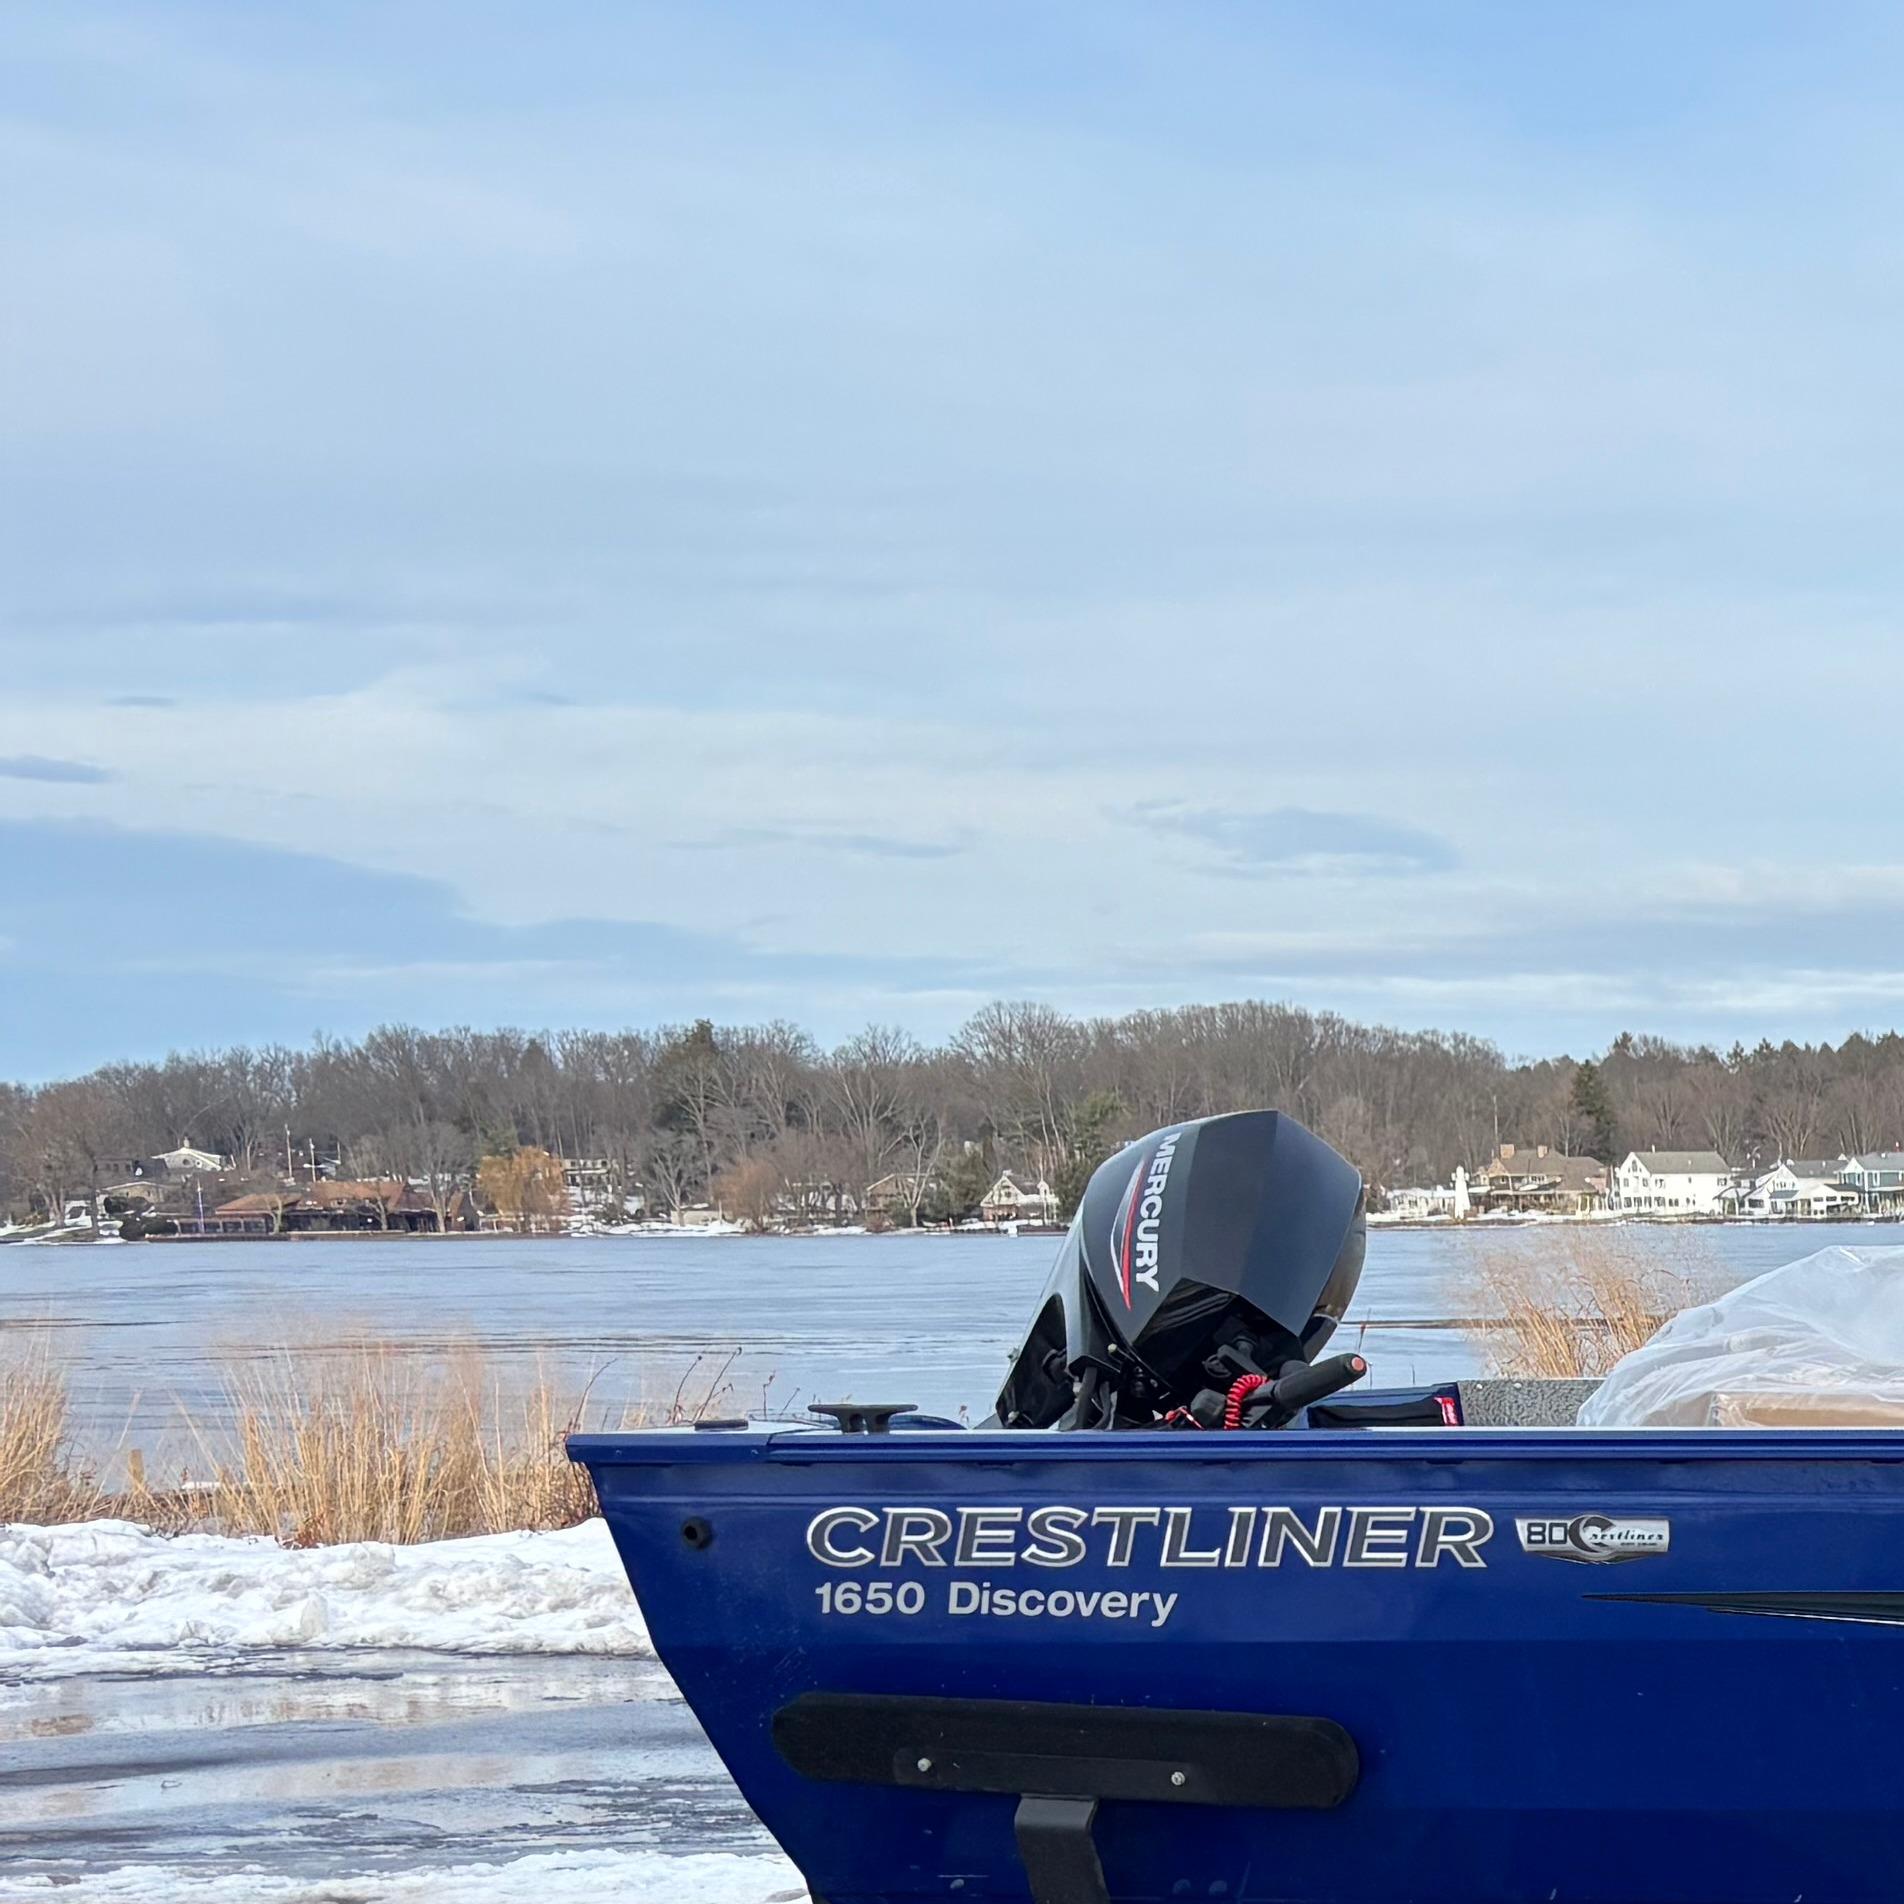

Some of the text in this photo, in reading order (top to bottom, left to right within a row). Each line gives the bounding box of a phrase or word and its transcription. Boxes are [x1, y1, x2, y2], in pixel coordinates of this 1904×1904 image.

[1135, 1132, 1182, 1293] MERCURY
[806, 1506, 1495, 1569] CRESTLINER
[1527, 1522, 1568, 1545] 80
[815, 1581, 1178, 1628] 1650 Discovery
